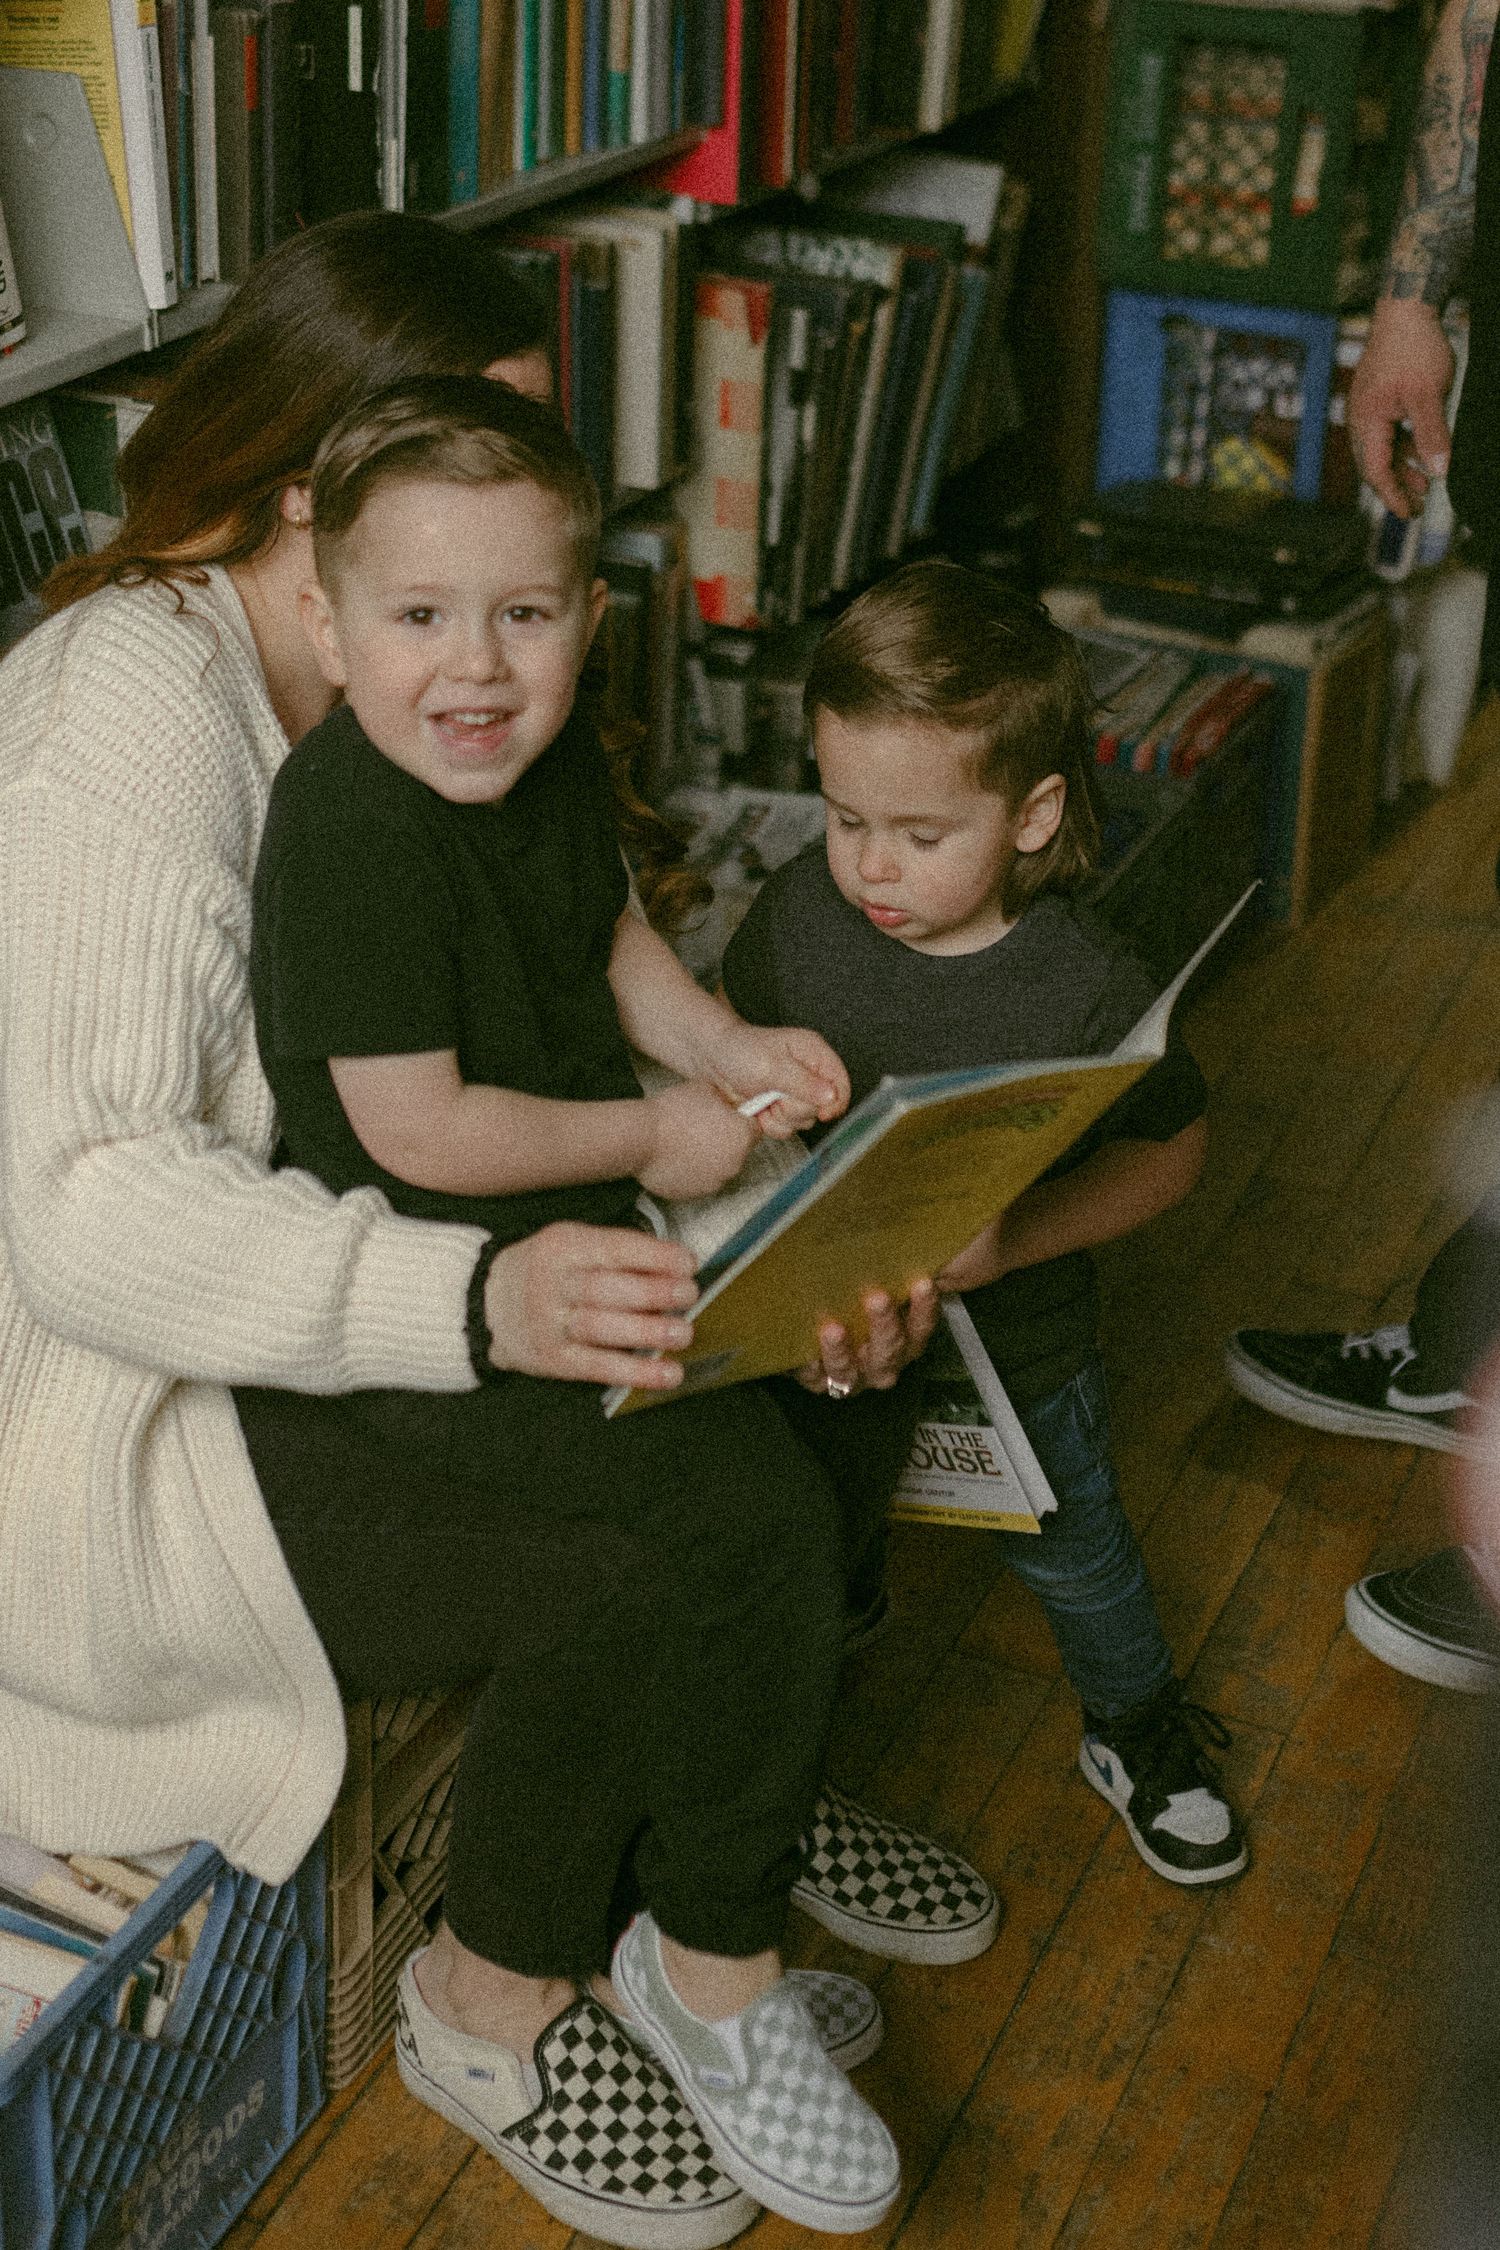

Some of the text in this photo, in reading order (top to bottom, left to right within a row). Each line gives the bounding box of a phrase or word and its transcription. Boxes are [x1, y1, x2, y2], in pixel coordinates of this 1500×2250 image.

[918, 1426, 987, 1448] IN THE
[906, 1443, 1003, 1476] OUSE
[163, 2079, 265, 2215] FOODS
